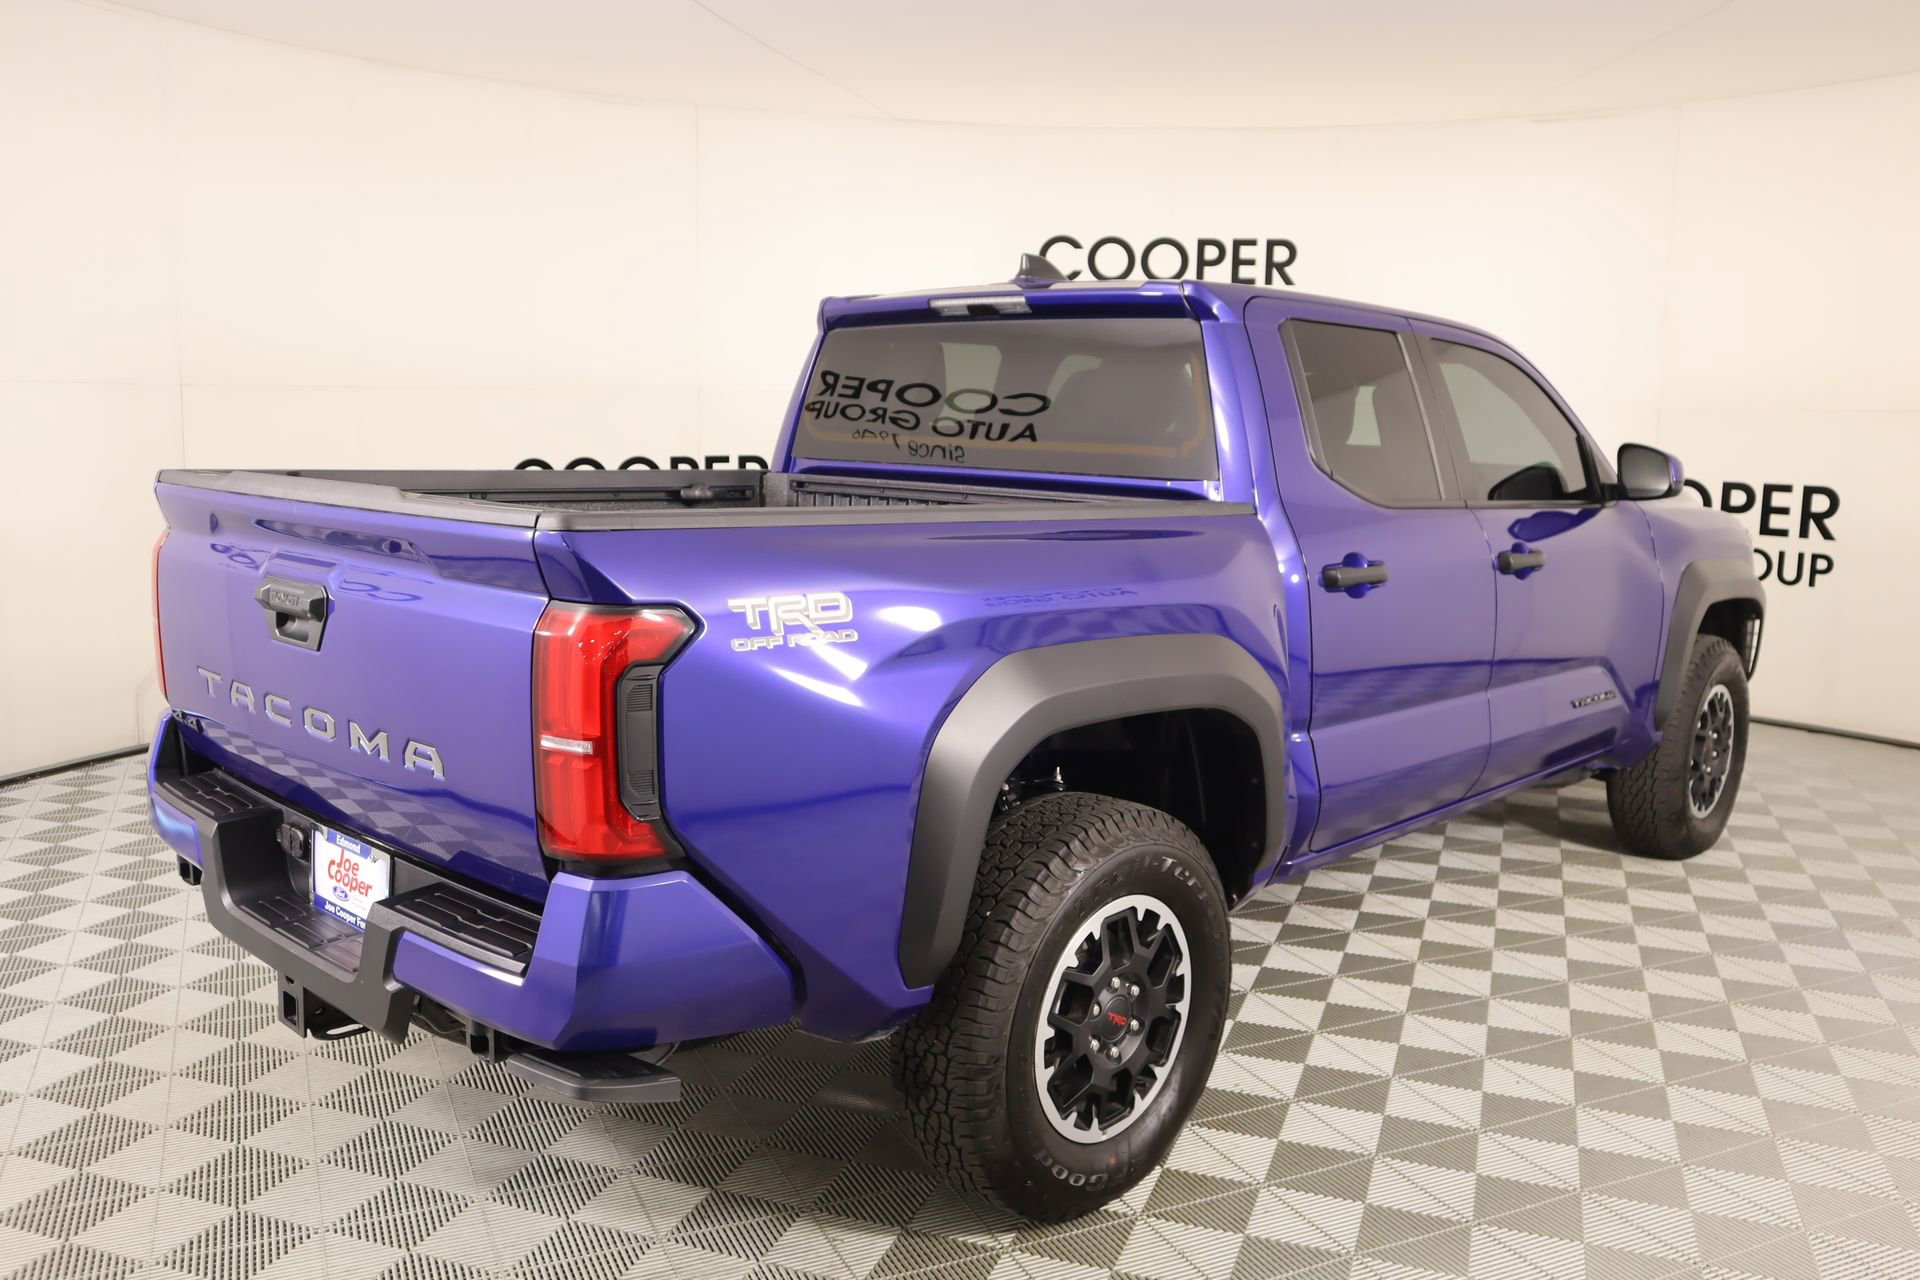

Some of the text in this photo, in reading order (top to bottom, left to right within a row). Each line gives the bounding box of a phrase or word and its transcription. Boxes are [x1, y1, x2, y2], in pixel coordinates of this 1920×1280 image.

[1038, 235, 1297, 285] COOPER
[1683, 479, 1840, 541] PER
[728, 592, 853, 635] TRD
[731, 629, 858, 651] OFF ROAD
[197, 665, 444, 780] TACOMA
[336, 834, 360, 854] Edmond
[336, 848, 359, 876] Joe
[328, 859, 373, 896] Cooper
[1107, 1012, 1128, 1025] TRD
